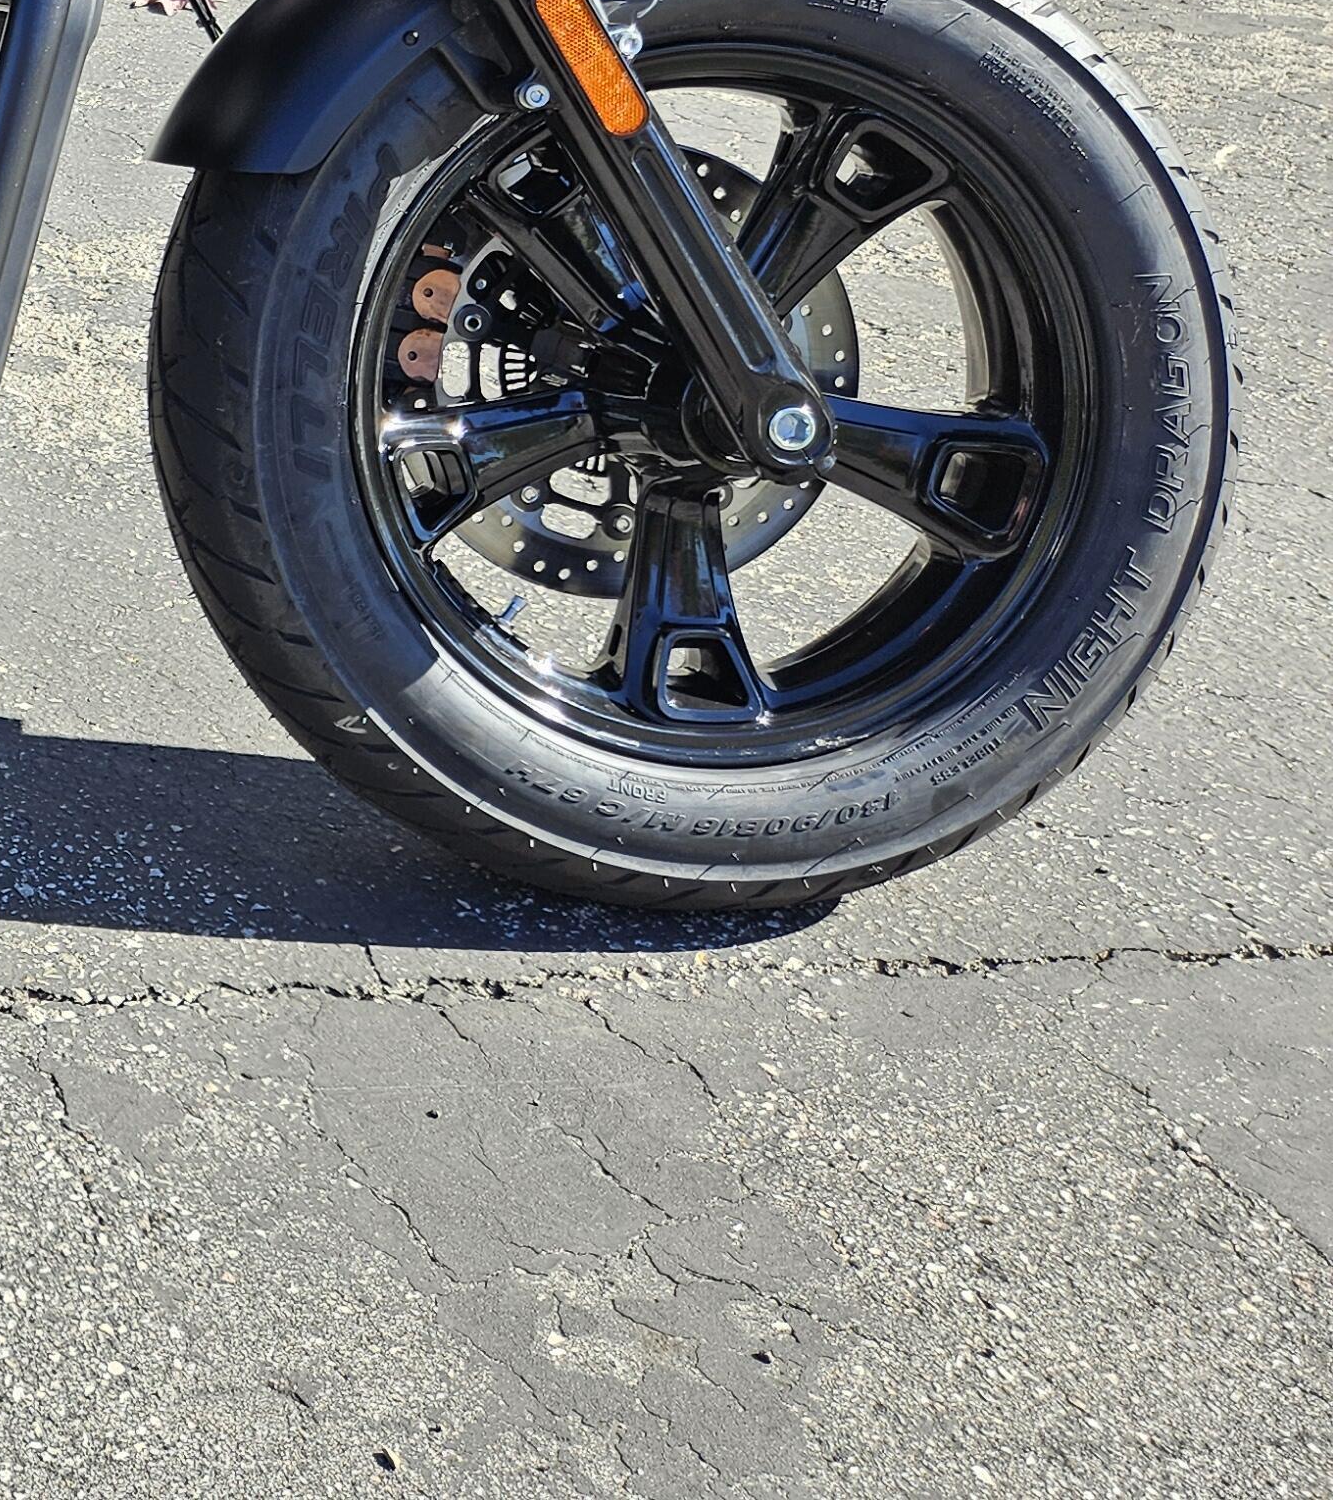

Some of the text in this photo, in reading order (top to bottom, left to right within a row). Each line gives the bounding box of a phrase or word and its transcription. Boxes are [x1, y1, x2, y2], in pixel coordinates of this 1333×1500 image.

[1134, 272, 1192, 533] DRAGON
[1023, 544, 1155, 734] NIGHT
[593, 798, 687, 835] M/C
[607, 778, 668, 804] FRONT
